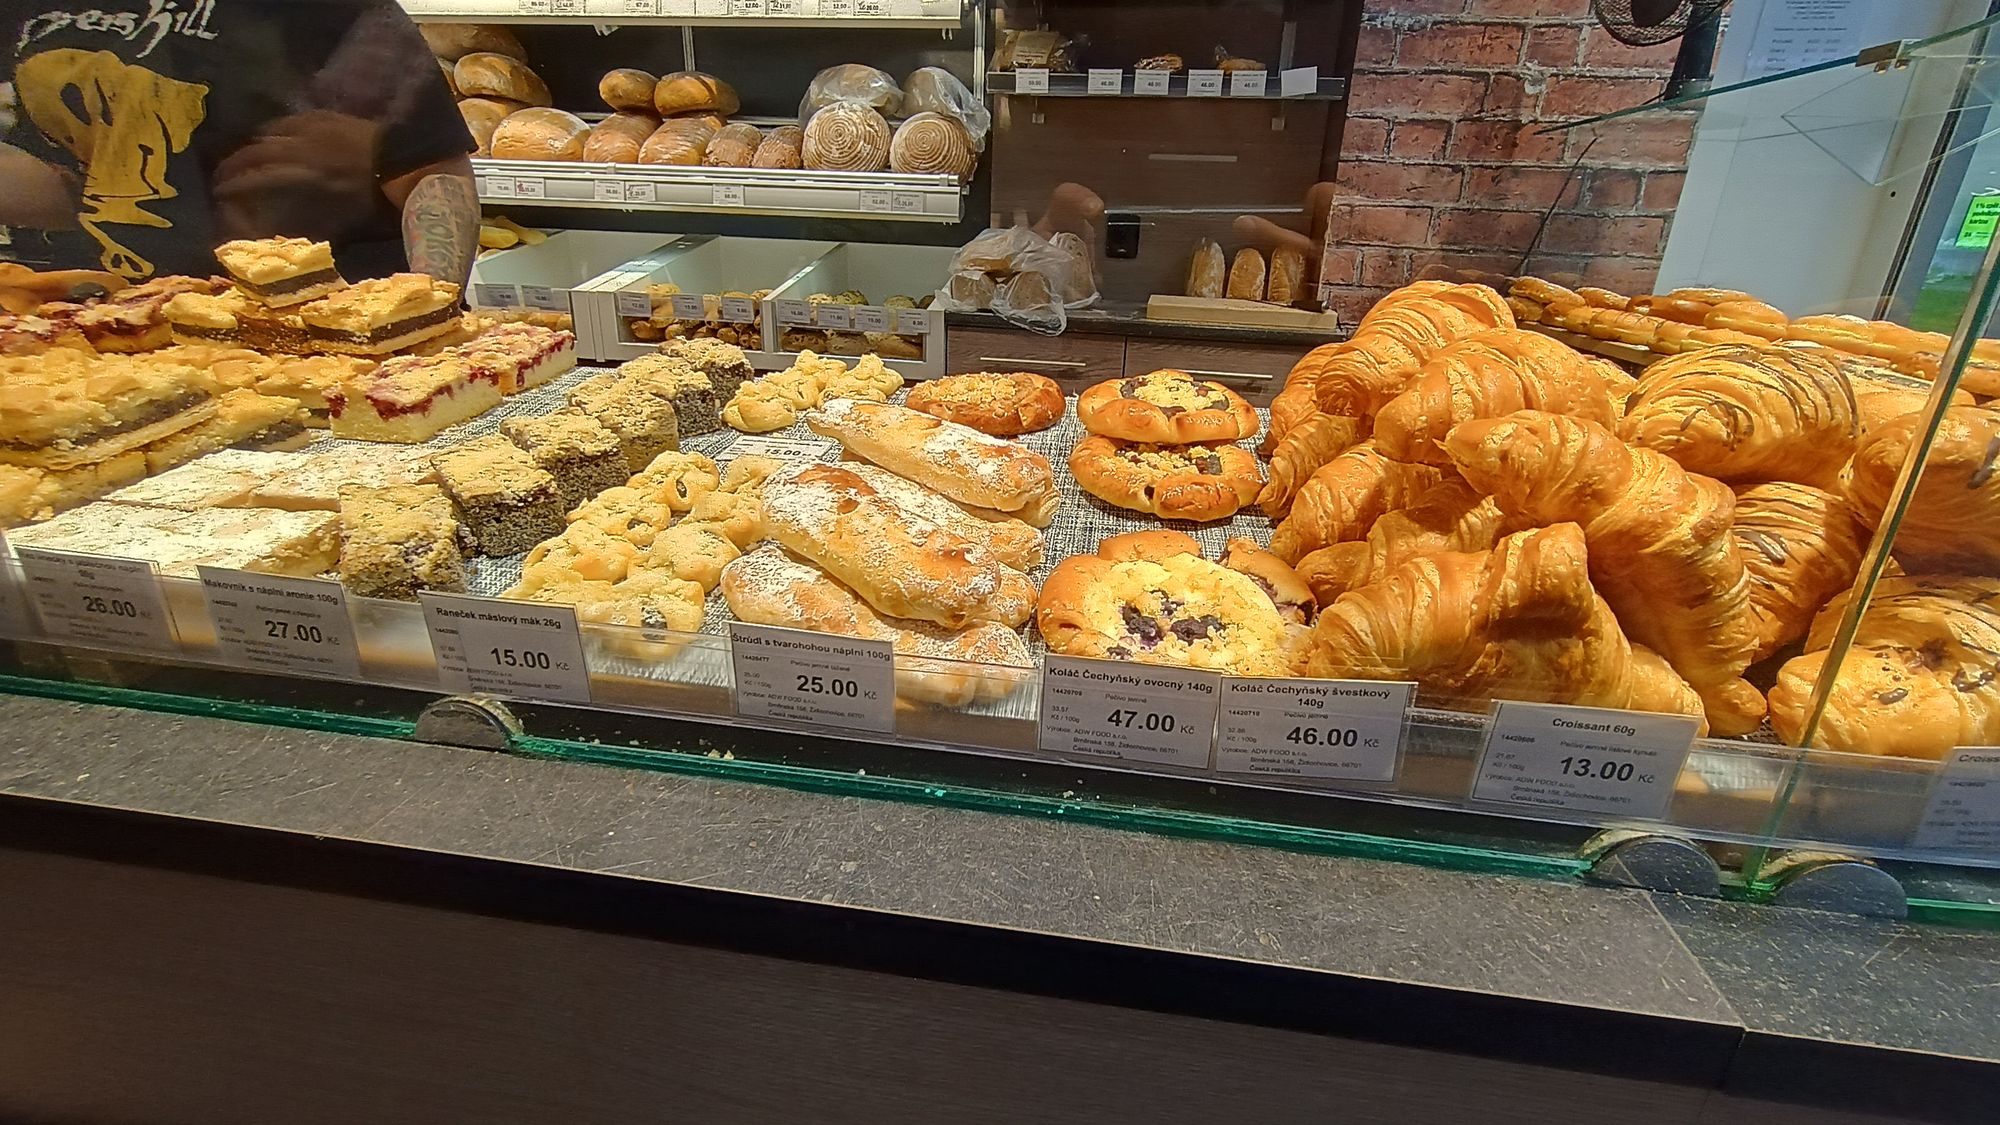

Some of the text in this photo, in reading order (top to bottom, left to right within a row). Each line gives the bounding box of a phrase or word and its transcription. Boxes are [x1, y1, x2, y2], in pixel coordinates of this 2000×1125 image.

[83, 596, 137, 618] 26.00
[286, 590, 314, 601] aronie
[316, 594, 338, 605] 100g
[436, 607, 562, 629] Raneček máslový mák 26g
[265, 619, 322, 644] 27.00
[490, 647, 571, 671] 15.00 Kč
[866, 650, 891, 662] 100g
[796, 674, 877, 700] 25.00 Kč
[1049, 667, 1213, 694] Koláč Čechyňský ovocný 140g
[1231, 684, 1391, 699] Koláč Čechyňský švestkový
[1298, 698, 1324, 709] 140g
[1107, 709, 1195, 735] 47.00 Kč
[1552, 718, 1636, 737] Croissant 60g
[1286, 727, 1379, 748] 46.00 Kč
[1560, 756, 1656, 784] 13.00 Kč
